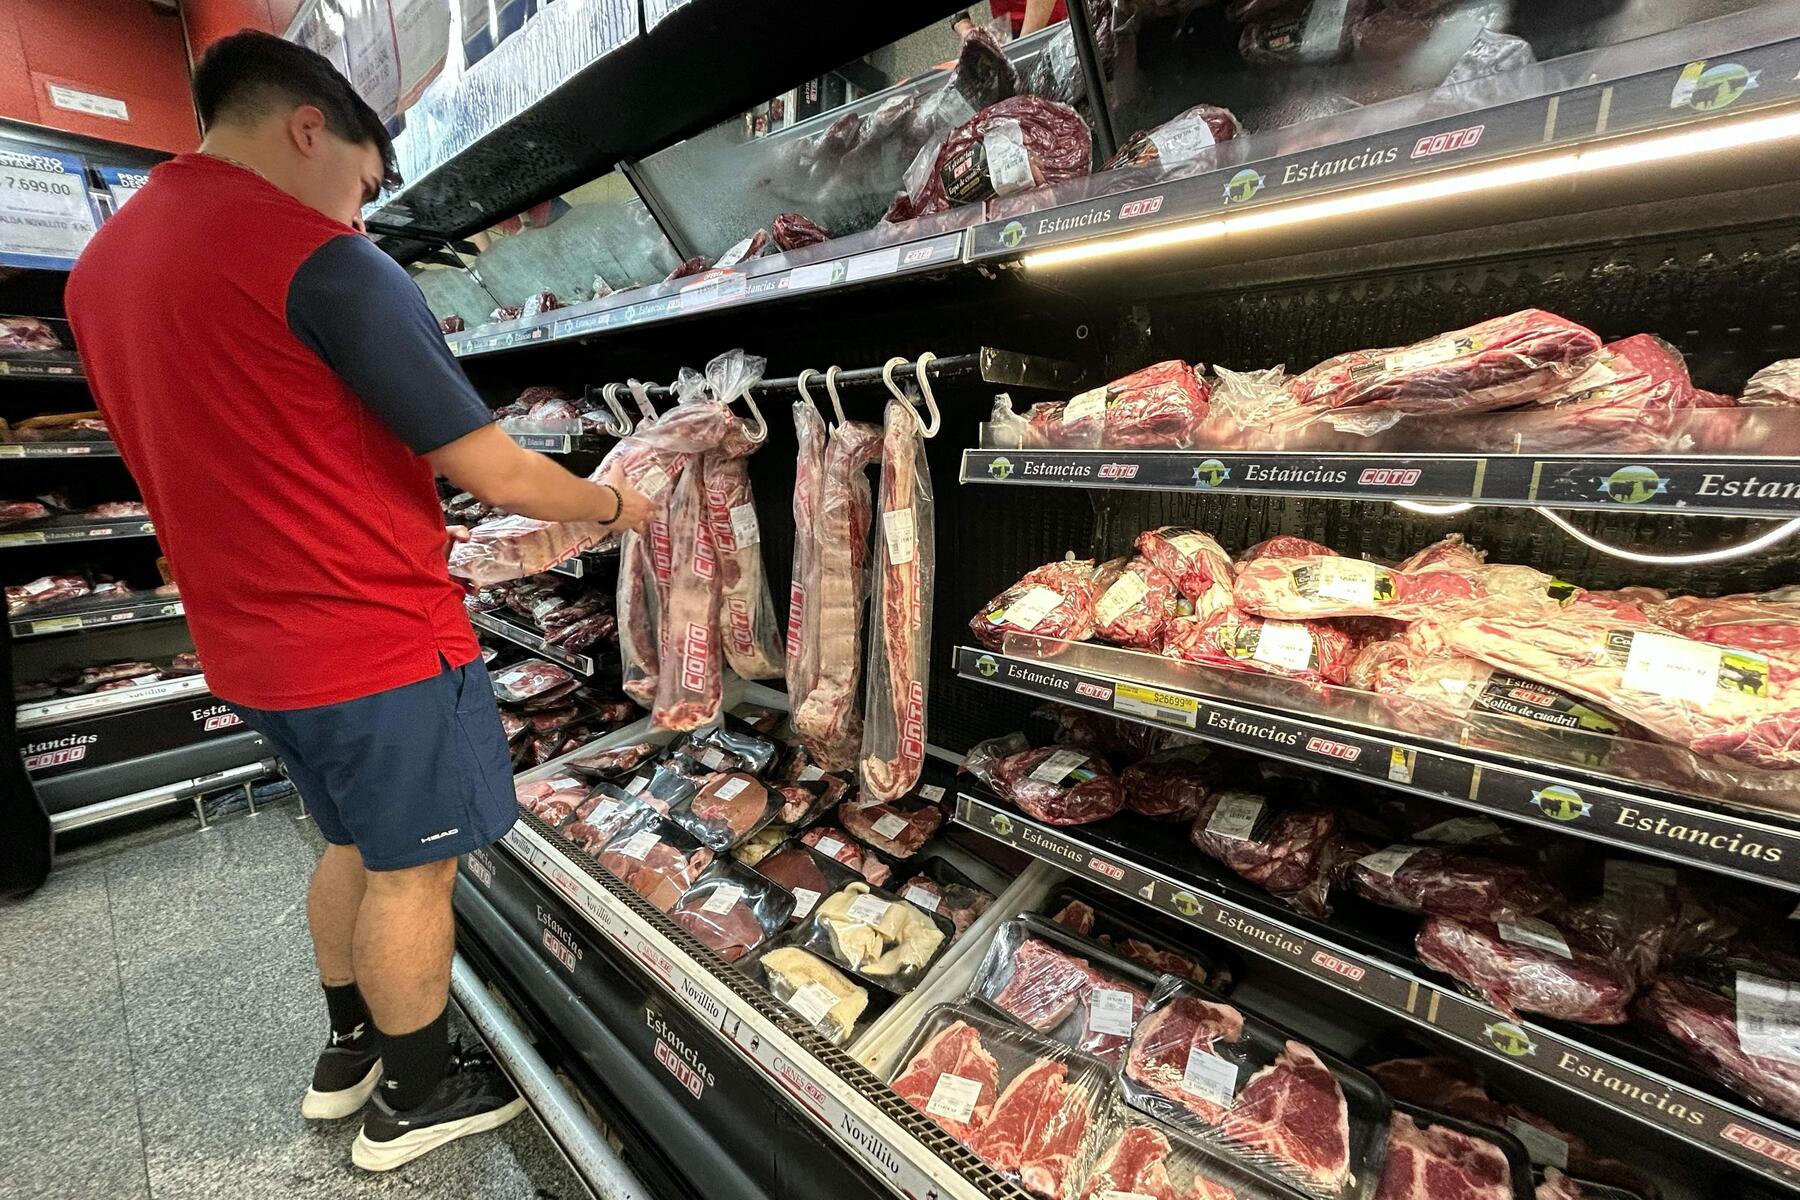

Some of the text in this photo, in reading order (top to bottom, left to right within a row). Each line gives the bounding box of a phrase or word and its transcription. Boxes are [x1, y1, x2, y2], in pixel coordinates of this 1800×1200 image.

[1281, 124, 1485, 184] Estancias COTO
[1037, 195, 1164, 236] Estancias COTO
[743, 282, 776, 294] stancias
[1023, 460, 1139, 479] Estancias COTO
[1245, 464, 1422, 487] Estancias COTO
[706, 487, 738, 553] COTO
[82, 615, 107, 624] ncias
[726, 597, 755, 657] COTO
[681, 622, 710, 693] COTO
[1008, 663, 1113, 701] Estancias COTO
[1508, 687, 1558, 707] COTO
[191, 703, 231, 721] Esta
[204, 713, 244, 731] COT
[903, 680, 924, 761] COTO
[1518, 706, 1534, 717] de
[1533, 711, 1578, 728] cuadril
[19, 732, 98, 756] stancias
[25, 745, 86, 770] COTO
[1207, 711, 1362, 763] Estancias COTO
[420, 827, 460, 845] HEAD
[1022, 827, 1125, 881] Estancias COTO
[1615, 805, 1783, 864] Estancias
[467, 852, 493, 889] COTO
[583, 894, 613, 926] Novillito
[536, 904, 584, 961] Estancias
[542, 927, 577, 974] COTO
[1215, 909, 1366, 982] Estancias COTO
[680, 977, 720, 1019] Novillito
[645, 1008, 716, 1088] Estancias
[653, 1037, 705, 1101] COTO
[1556, 1051, 1706, 1126] Estancias
[804, 1082, 828, 1105] COTO
[840, 1112, 900, 1175] Novillito
